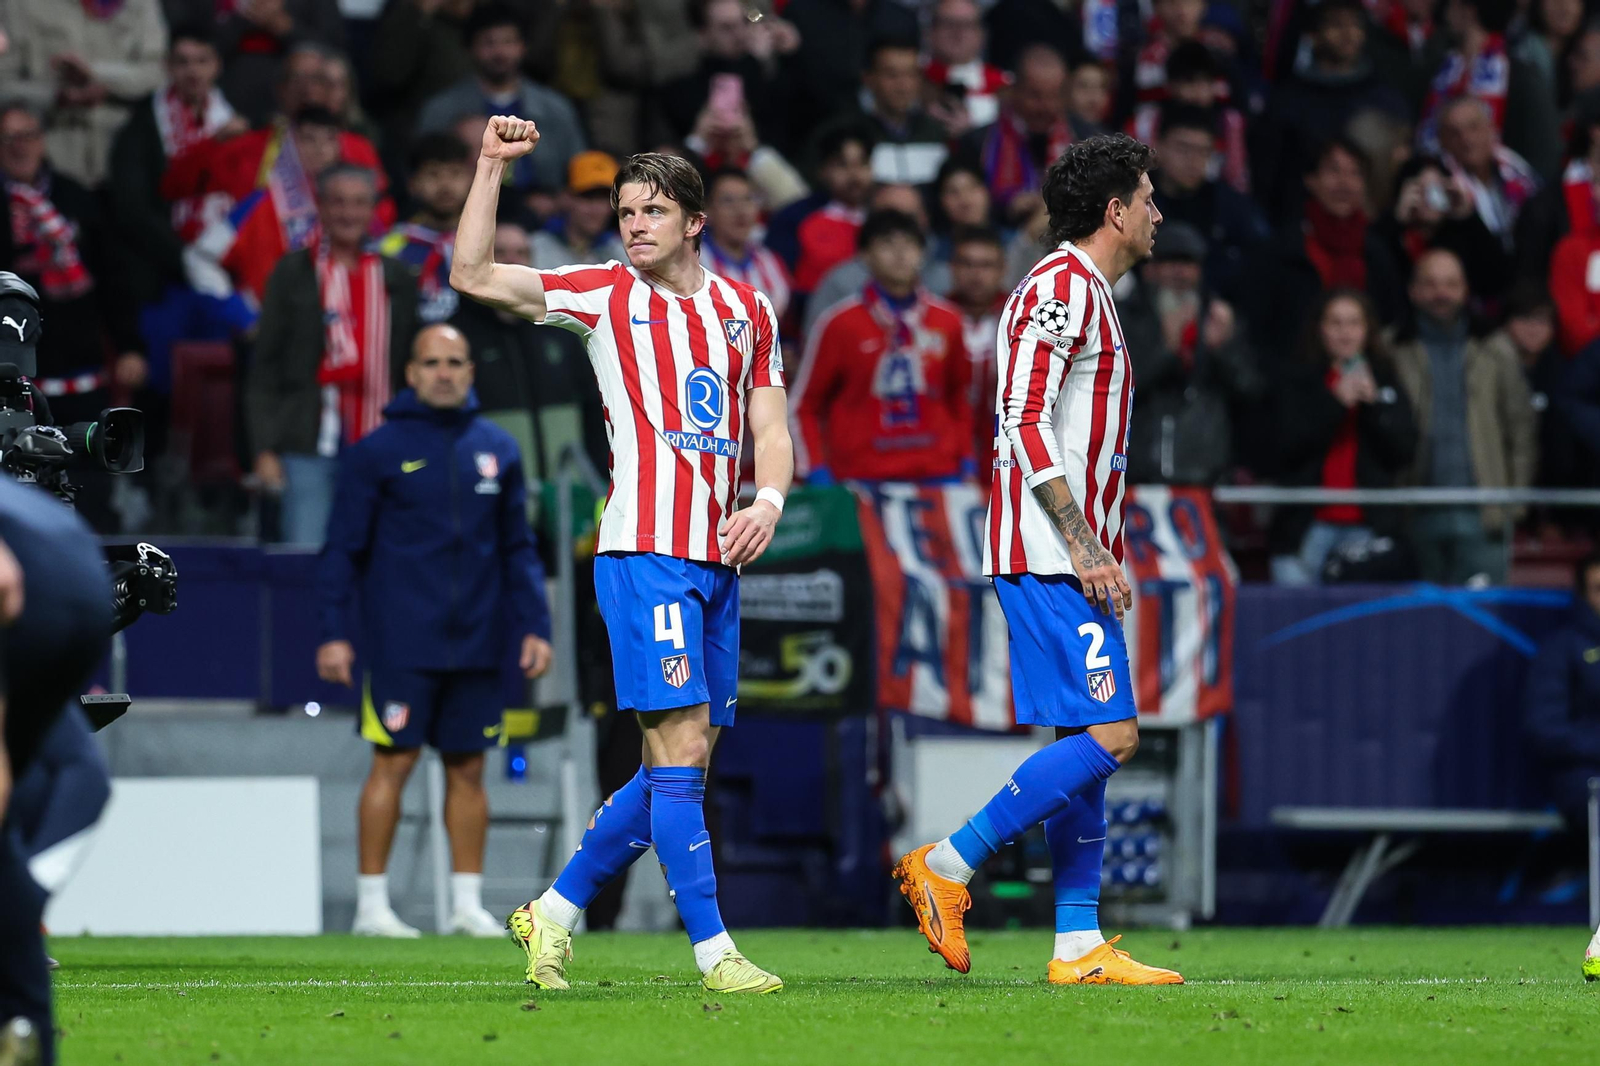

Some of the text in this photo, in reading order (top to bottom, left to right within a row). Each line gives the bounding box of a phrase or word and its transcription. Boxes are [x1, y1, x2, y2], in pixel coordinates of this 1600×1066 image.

[665, 432, 738, 457] RIYADH AIR
[654, 601, 685, 650] 4
[1077, 622, 1110, 670] 2
